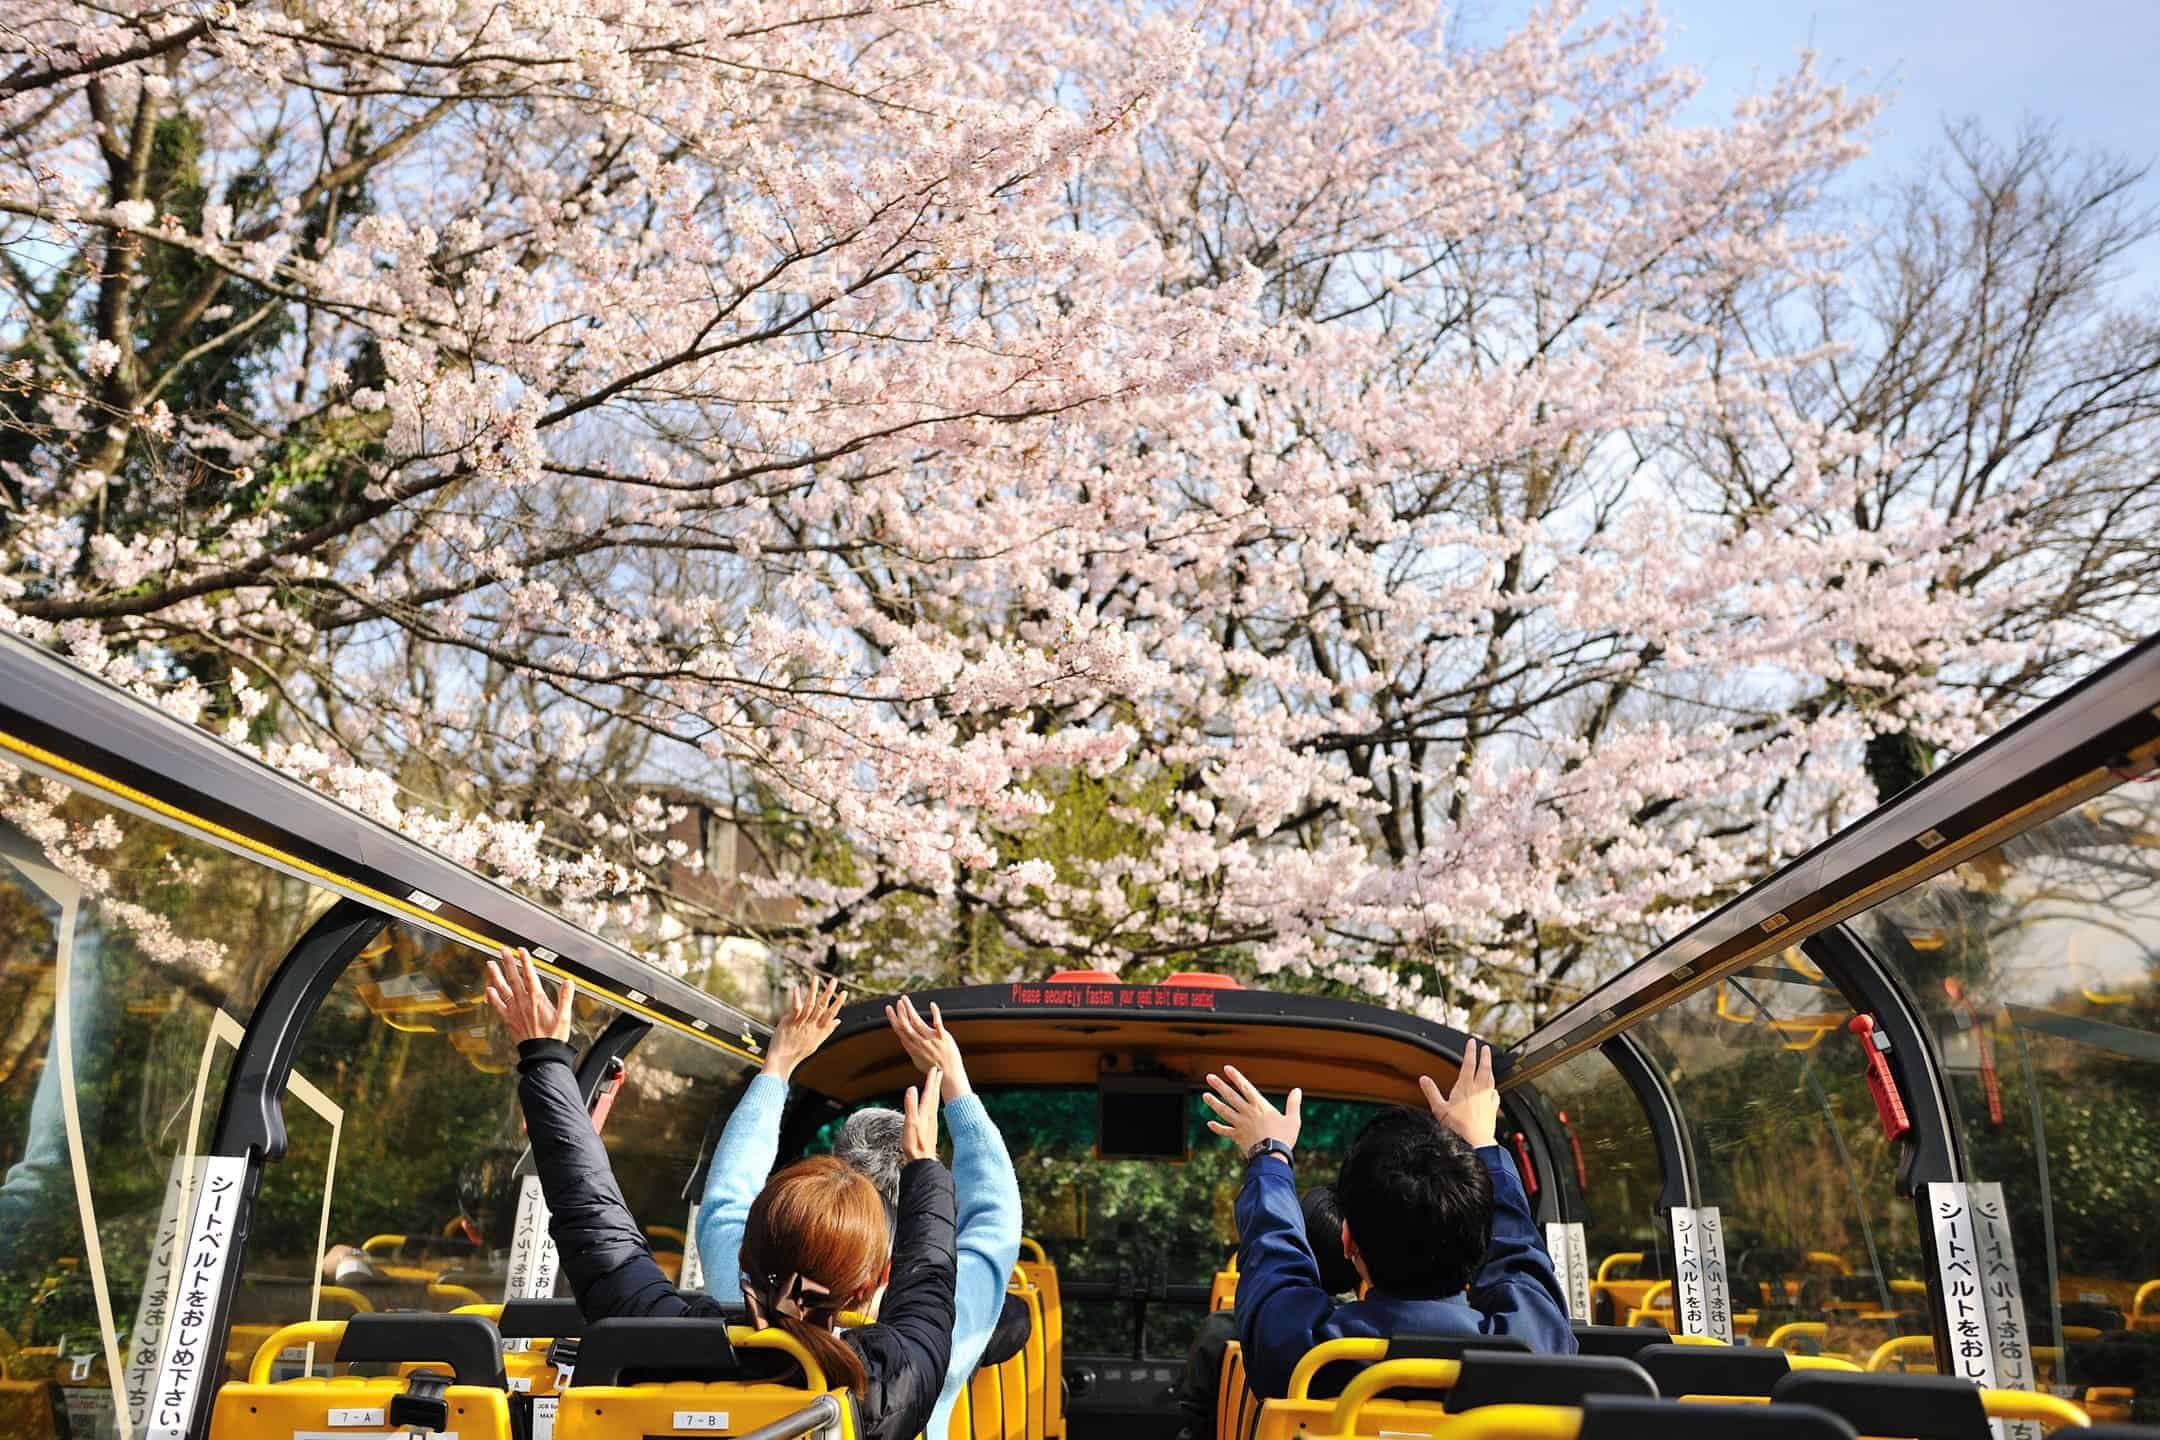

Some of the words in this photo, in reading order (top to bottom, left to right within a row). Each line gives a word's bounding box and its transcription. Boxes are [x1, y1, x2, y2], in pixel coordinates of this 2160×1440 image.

[1011, 983, 1041, 1004] Please
[1044, 984, 1082, 1008] securely
[1086, 984, 1114, 1006] fasten
[159, 1174, 234, 1439] シートベルトをおしめ下さい。
[1938, 1201, 1989, 1389] シートベルトをおし
